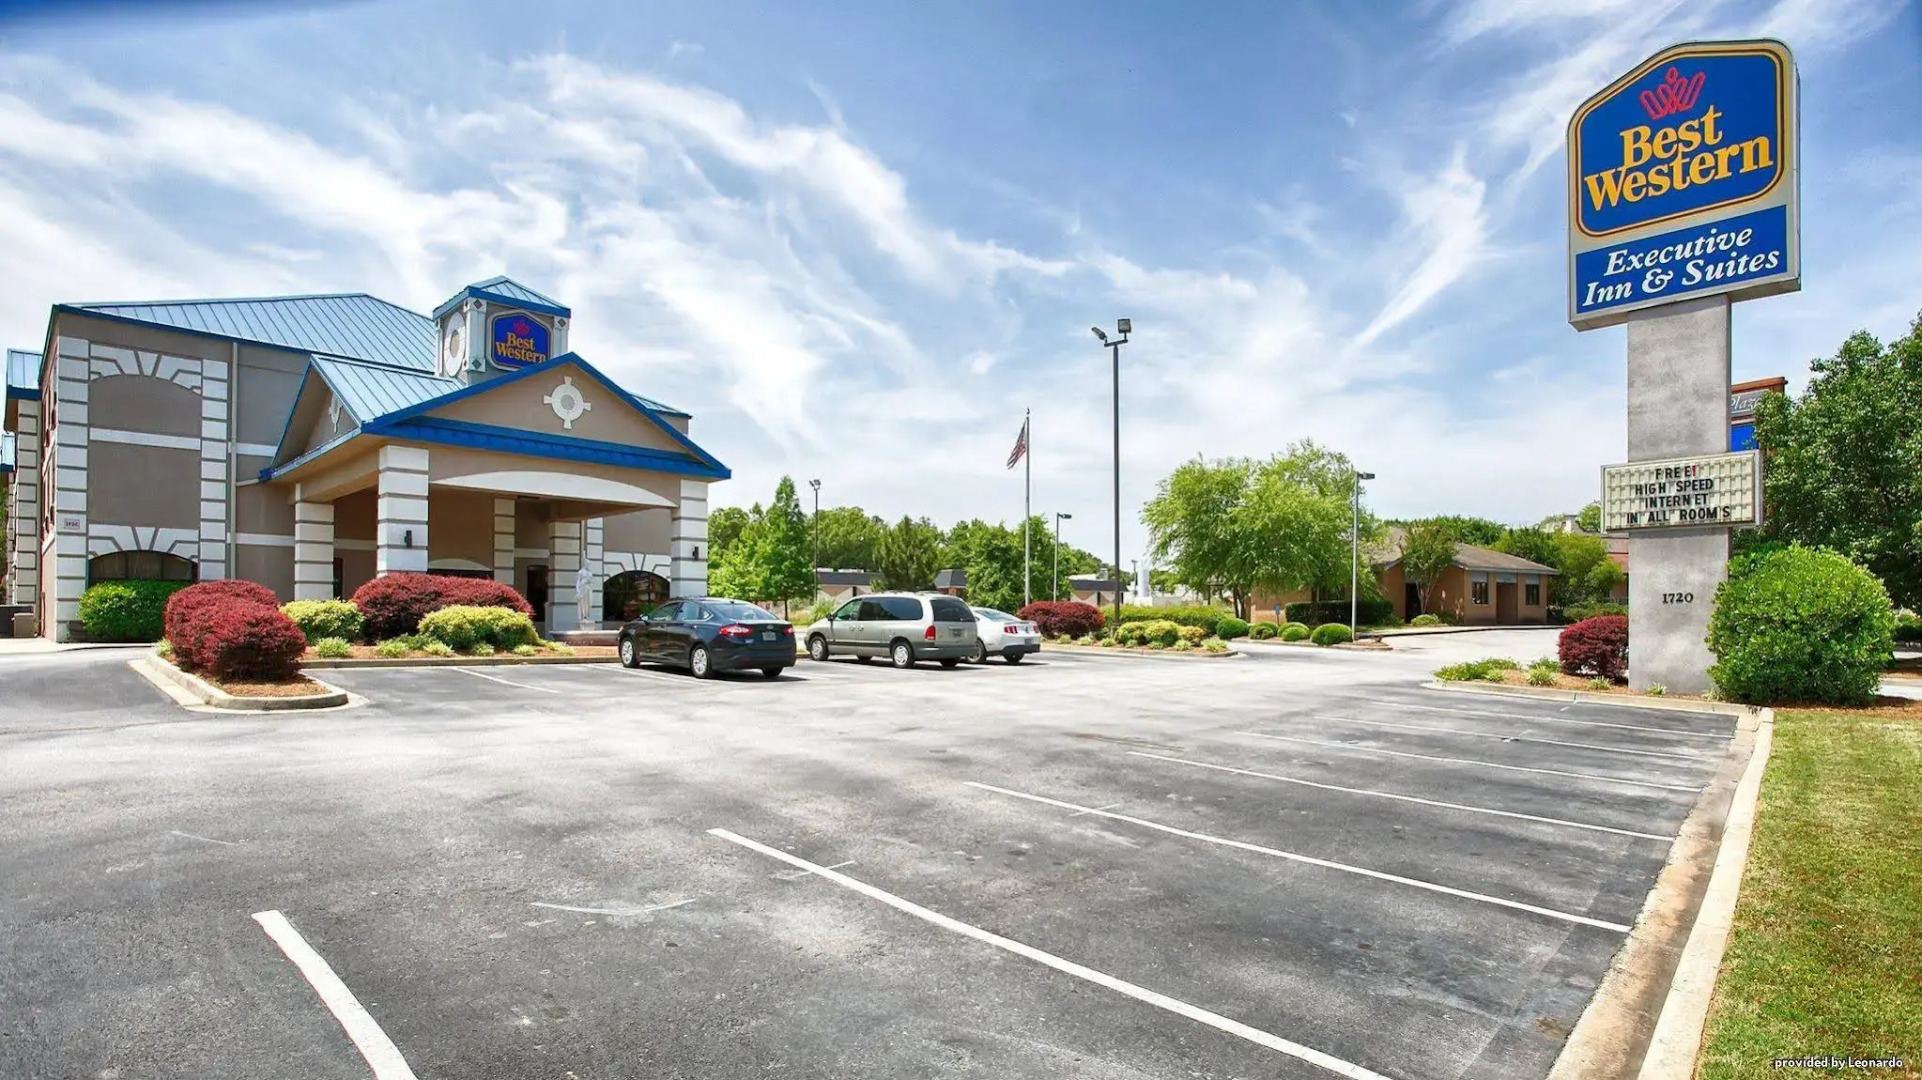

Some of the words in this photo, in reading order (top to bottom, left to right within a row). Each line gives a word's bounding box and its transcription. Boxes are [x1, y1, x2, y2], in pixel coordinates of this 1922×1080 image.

[1620, 104, 1723, 169] Best
[1584, 135, 1774, 212] Western
[1603, 227, 1753, 277] Executive
[1581, 281, 1633, 307] Inn
[1641, 268, 1675, 294] &
[1681, 249, 1780, 286] Suites
[507, 331, 535, 351] Best
[495, 341, 547, 364] Western
[1635, 482, 1667, 495] HIGH
[1675, 478, 1714, 493] SPEED
[1644, 493, 1709, 509] INTERNET
[1626, 512, 1638, 524] IN
[1647, 510, 1670, 523] ALL
[1662, 591, 1694, 605] 1720
